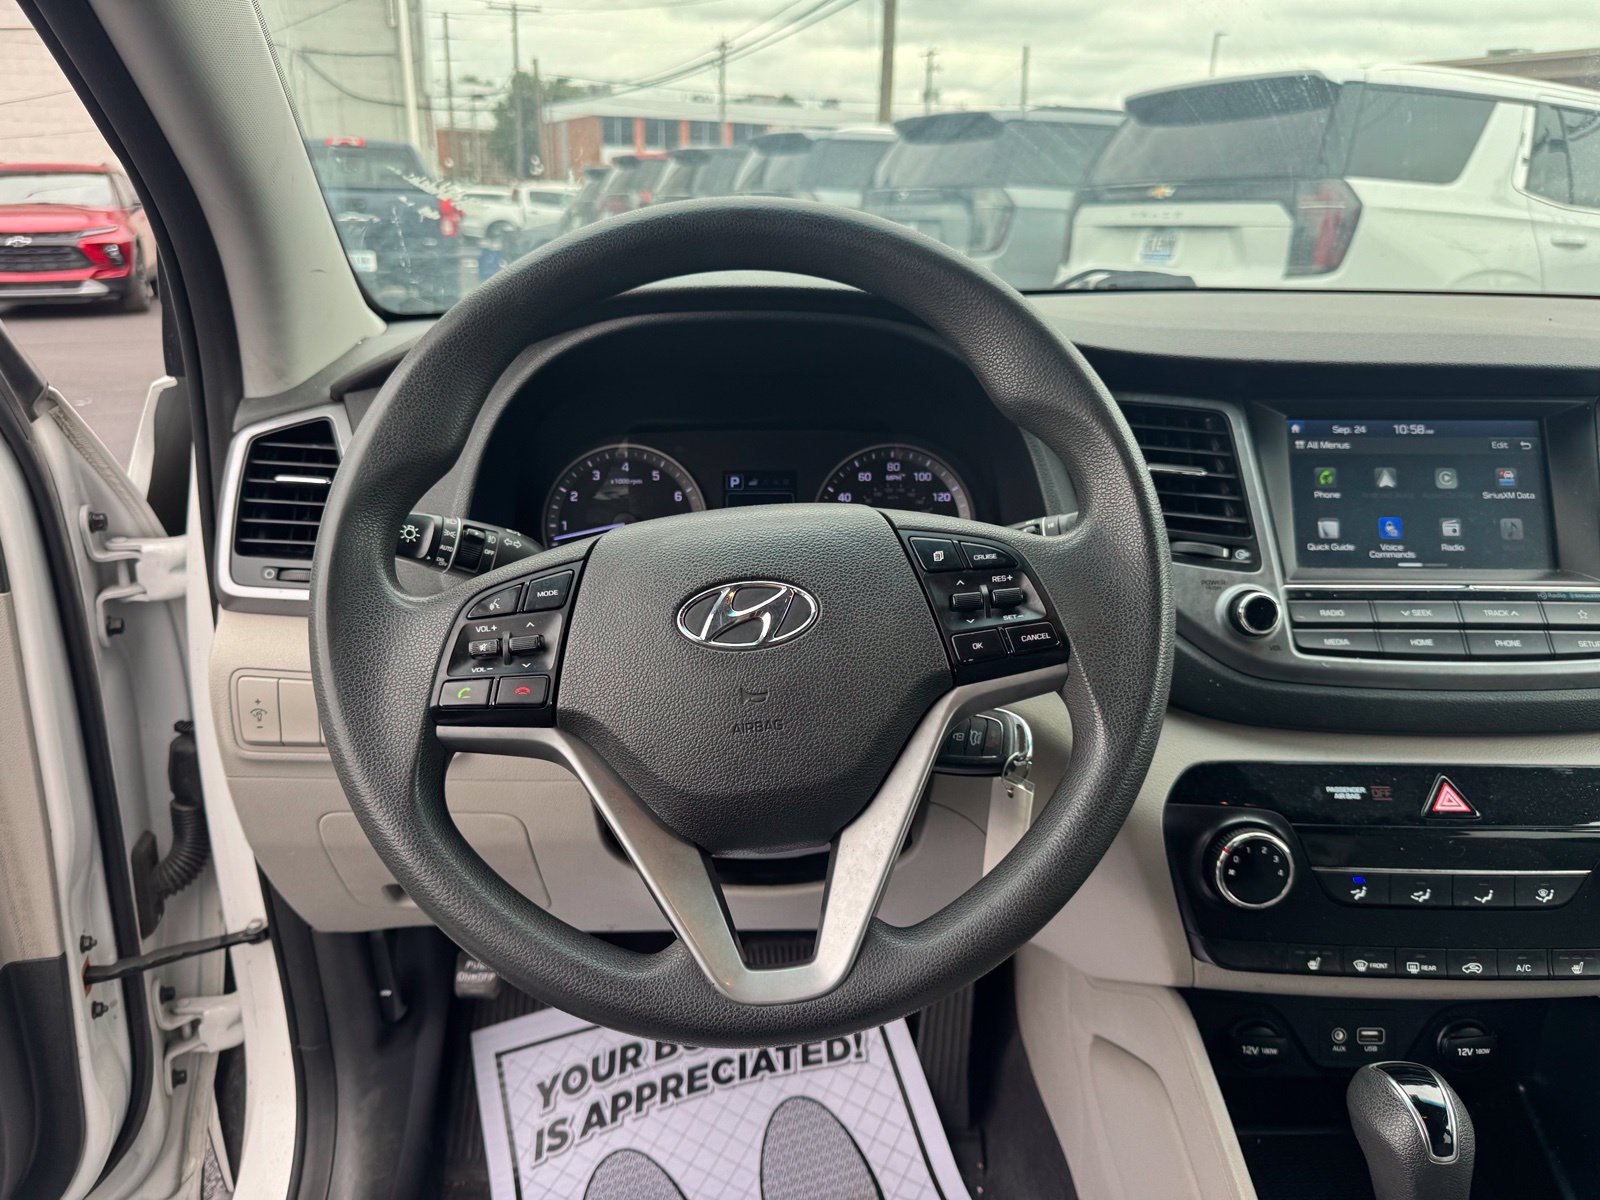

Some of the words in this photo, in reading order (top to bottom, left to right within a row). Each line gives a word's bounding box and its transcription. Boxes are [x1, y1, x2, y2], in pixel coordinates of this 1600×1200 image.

[1332, 425, 1352, 435] Sep.
[1354, 425, 1366, 434] 24
[1393, 424, 1425, 434] 10:58
[1306, 441, 1319, 449] All
[1321, 441, 1350, 449] Menus
[1492, 441, 1508, 449] Edit
[622, 462, 629, 472] 4
[887, 463, 900, 472] 80
[592, 471, 600, 480] 3
[652, 471, 660, 480] 5
[858, 473, 872, 481] 60
[914, 473, 932, 481] 100
[730, 477, 740, 488] P
[570, 491, 578, 501] 2
[674, 491, 682, 501] 6
[838, 493, 851, 502] 40
[933, 493, 950, 502] 120
[1482, 491, 1515, 499] SiriusXM
[1517, 491, 1535, 499] Data
[562, 521, 567, 530] 1
[440, 544, 454, 552] AUTO
[1307, 543, 1330, 551] Quick
[1380, 543, 1404, 551] Voice
[1441, 543, 1465, 551] Radio
[484, 548, 494, 556] OFF
[992, 574, 1013, 582] RES+
[537, 589, 558, 597] MODE
[1320, 609, 1345, 617] RADIO
[476, 624, 497, 632] VOL+
[1021, 632, 1051, 642] CANCEL
[972, 642, 984, 650] OK
[1324, 638, 1350, 646] MEDIA
[1410, 638, 1433, 646] HOME
[733, 720, 783, 734] AIRBAG
[1326, 786, 1366, 794] PASSENGER
[1262, 846, 1268, 854] 2
[1233, 856, 1240, 864] 0
[1273, 856, 1279, 864] 3
[1369, 962, 1388, 970] FRONT
[1516, 964, 1532, 972] A/C
[1242, 1046, 1258, 1056] 12V
[1333, 1044, 1346, 1052] AUX
[1458, 1048, 1474, 1056] 12V
[536, 1041, 643, 1112] YOUR
[533, 1116, 569, 1163] IS
[579, 1033, 863, 1139] APPRECIATED!
